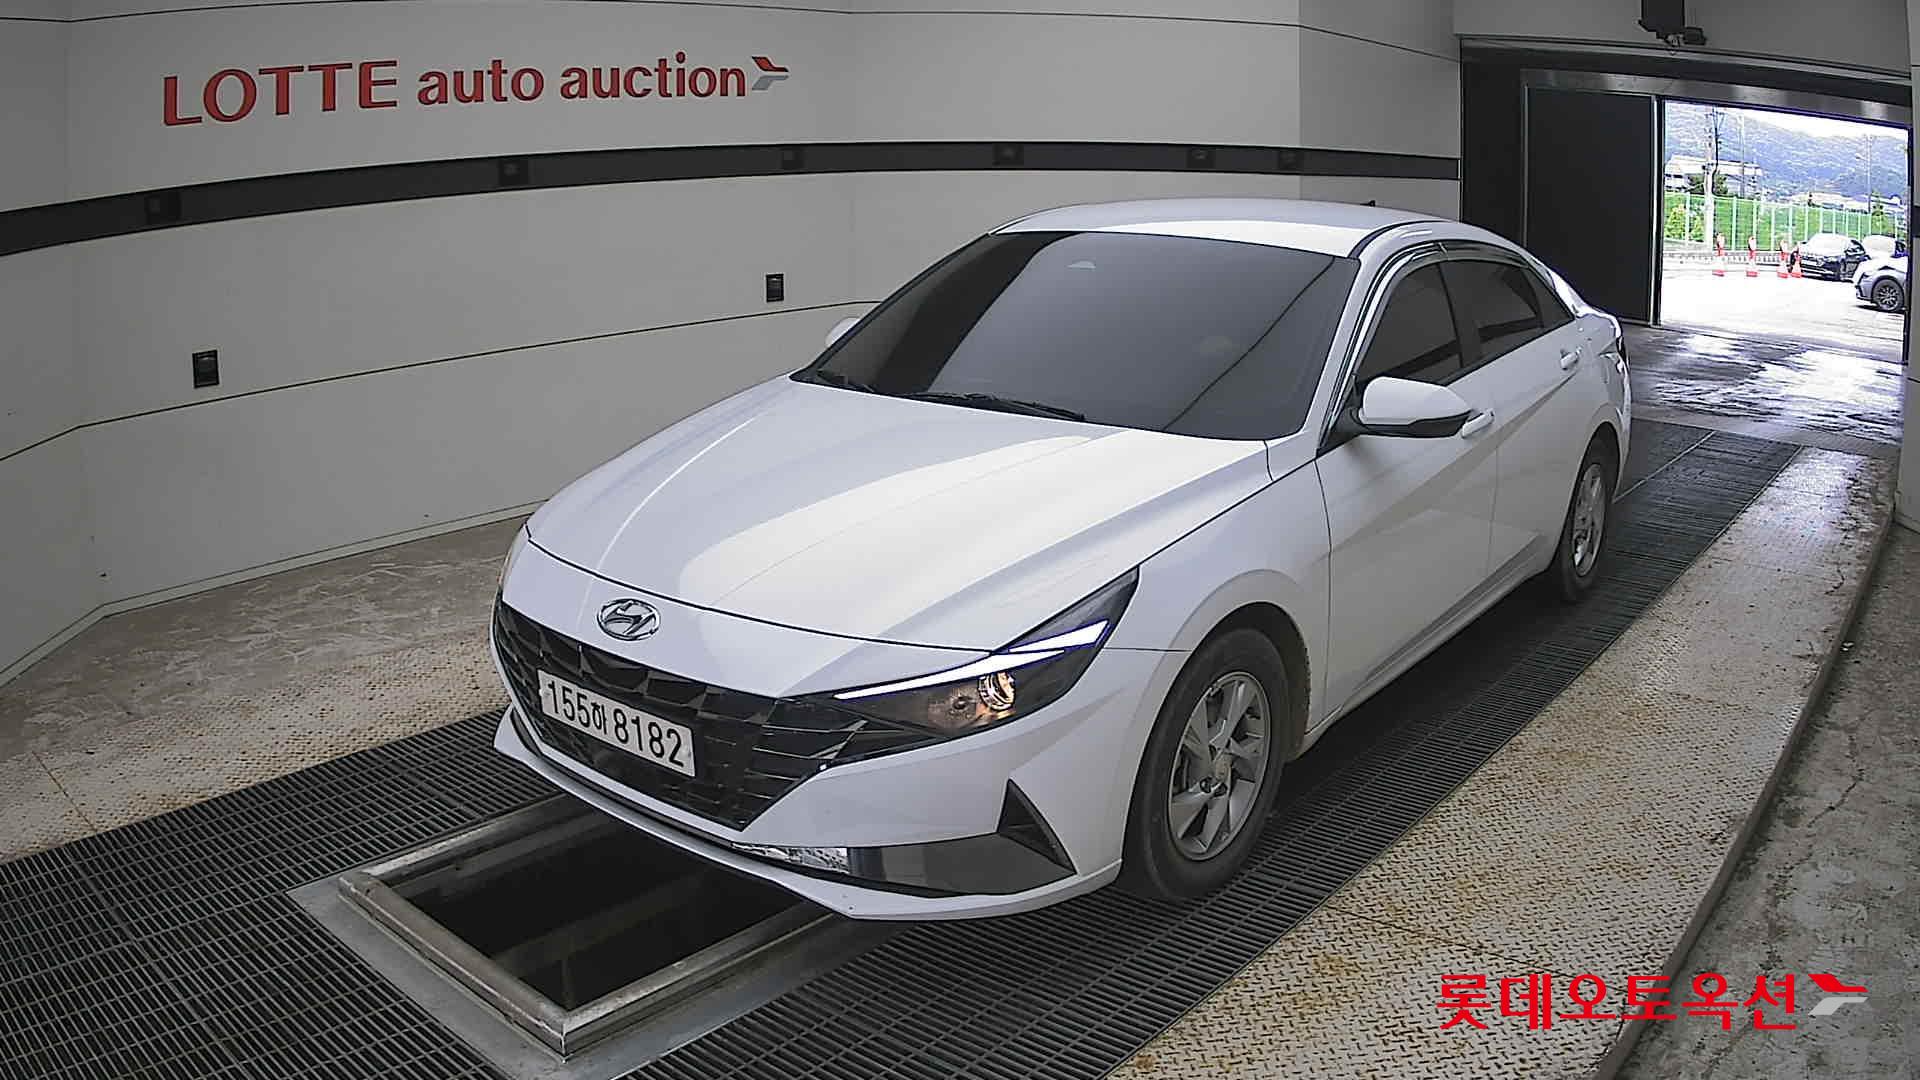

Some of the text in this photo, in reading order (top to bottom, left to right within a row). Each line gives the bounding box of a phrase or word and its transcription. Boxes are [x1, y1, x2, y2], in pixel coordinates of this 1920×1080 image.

[163, 51, 747, 127] LOTTE auto auction
[612, 707, 685, 768] 8182
